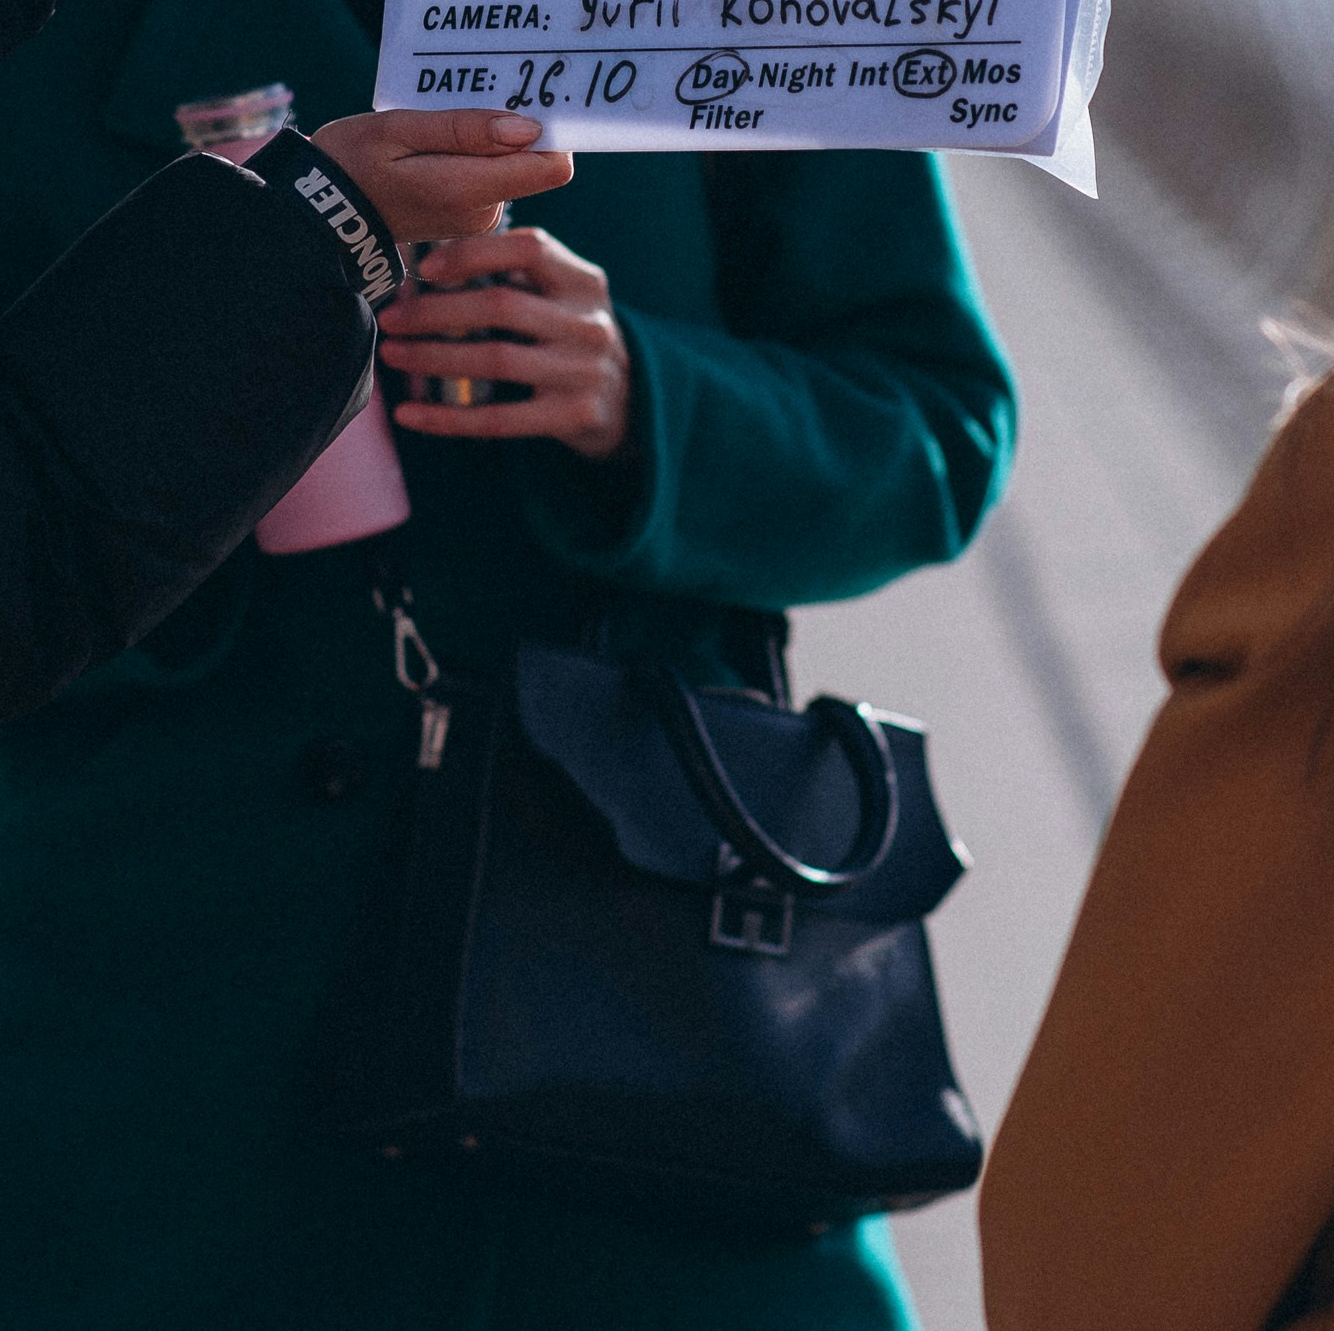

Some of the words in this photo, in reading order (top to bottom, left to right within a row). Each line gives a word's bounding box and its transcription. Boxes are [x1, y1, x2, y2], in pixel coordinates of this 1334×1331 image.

[423, 4, 551, 31] CAMERA:
[417, 67, 496, 93] DATE:
[505, 59, 637, 111] 26.10
[692, 63, 748, 94] Day
[758, 62, 836, 94] Night
[848, 61, 890, 87] Int
[902, 60, 949, 86] Ext
[961, 58, 1021, 85] Mos
[689, 104, 765, 130] Filter
[949, 97, 1019, 129] Sync
[294, 166, 396, 303] MONCLER
